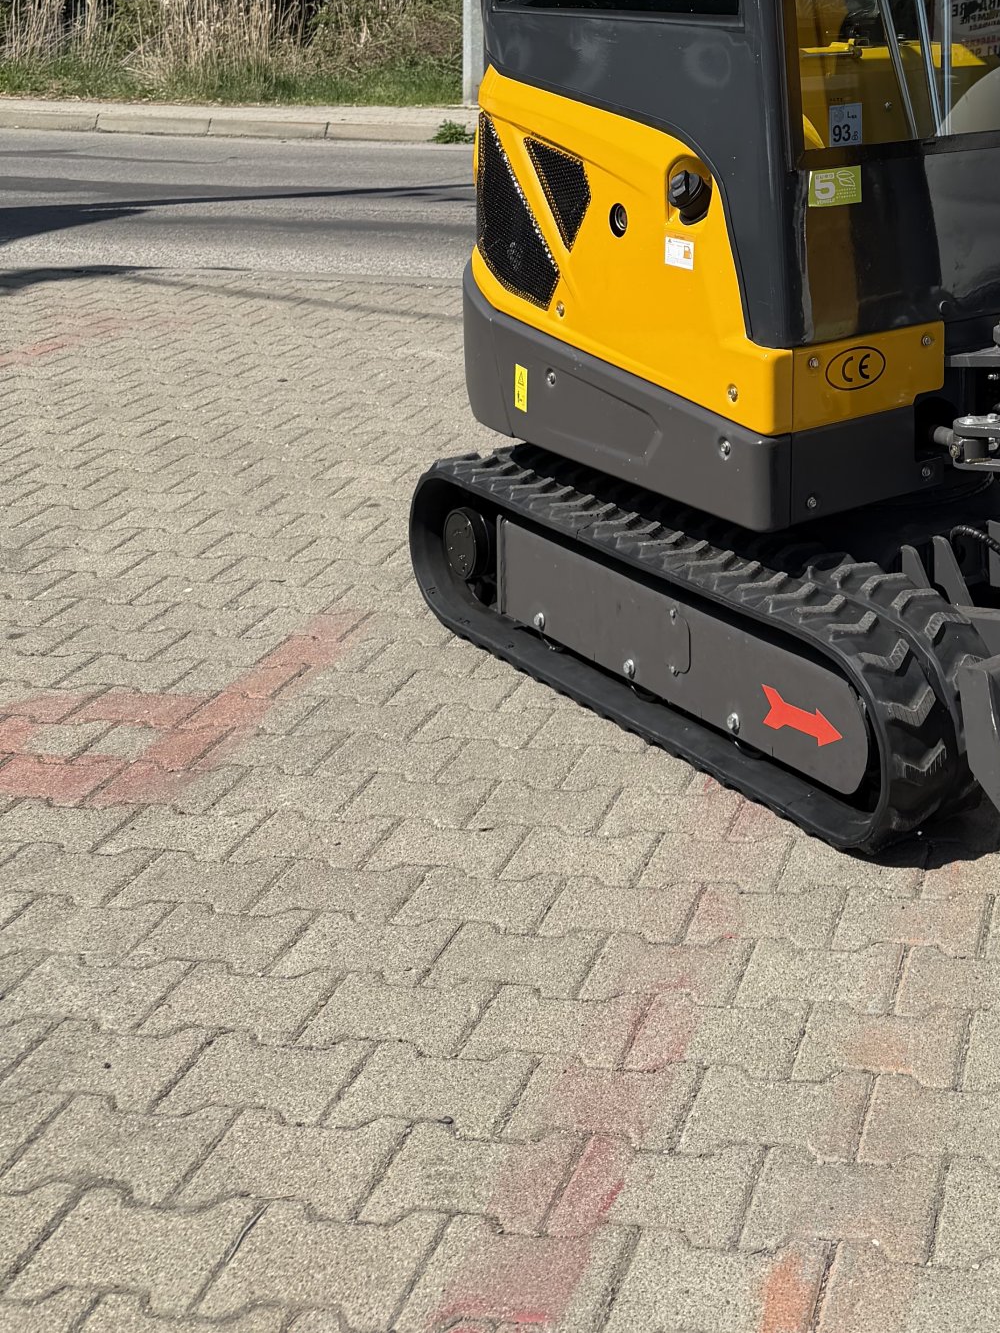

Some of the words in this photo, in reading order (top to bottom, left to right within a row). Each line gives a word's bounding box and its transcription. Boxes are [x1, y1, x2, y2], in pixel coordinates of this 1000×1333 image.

[832, 124, 851, 143] 93
[814, 172, 836, 200] 5
[842, 353, 871, 383] CE
